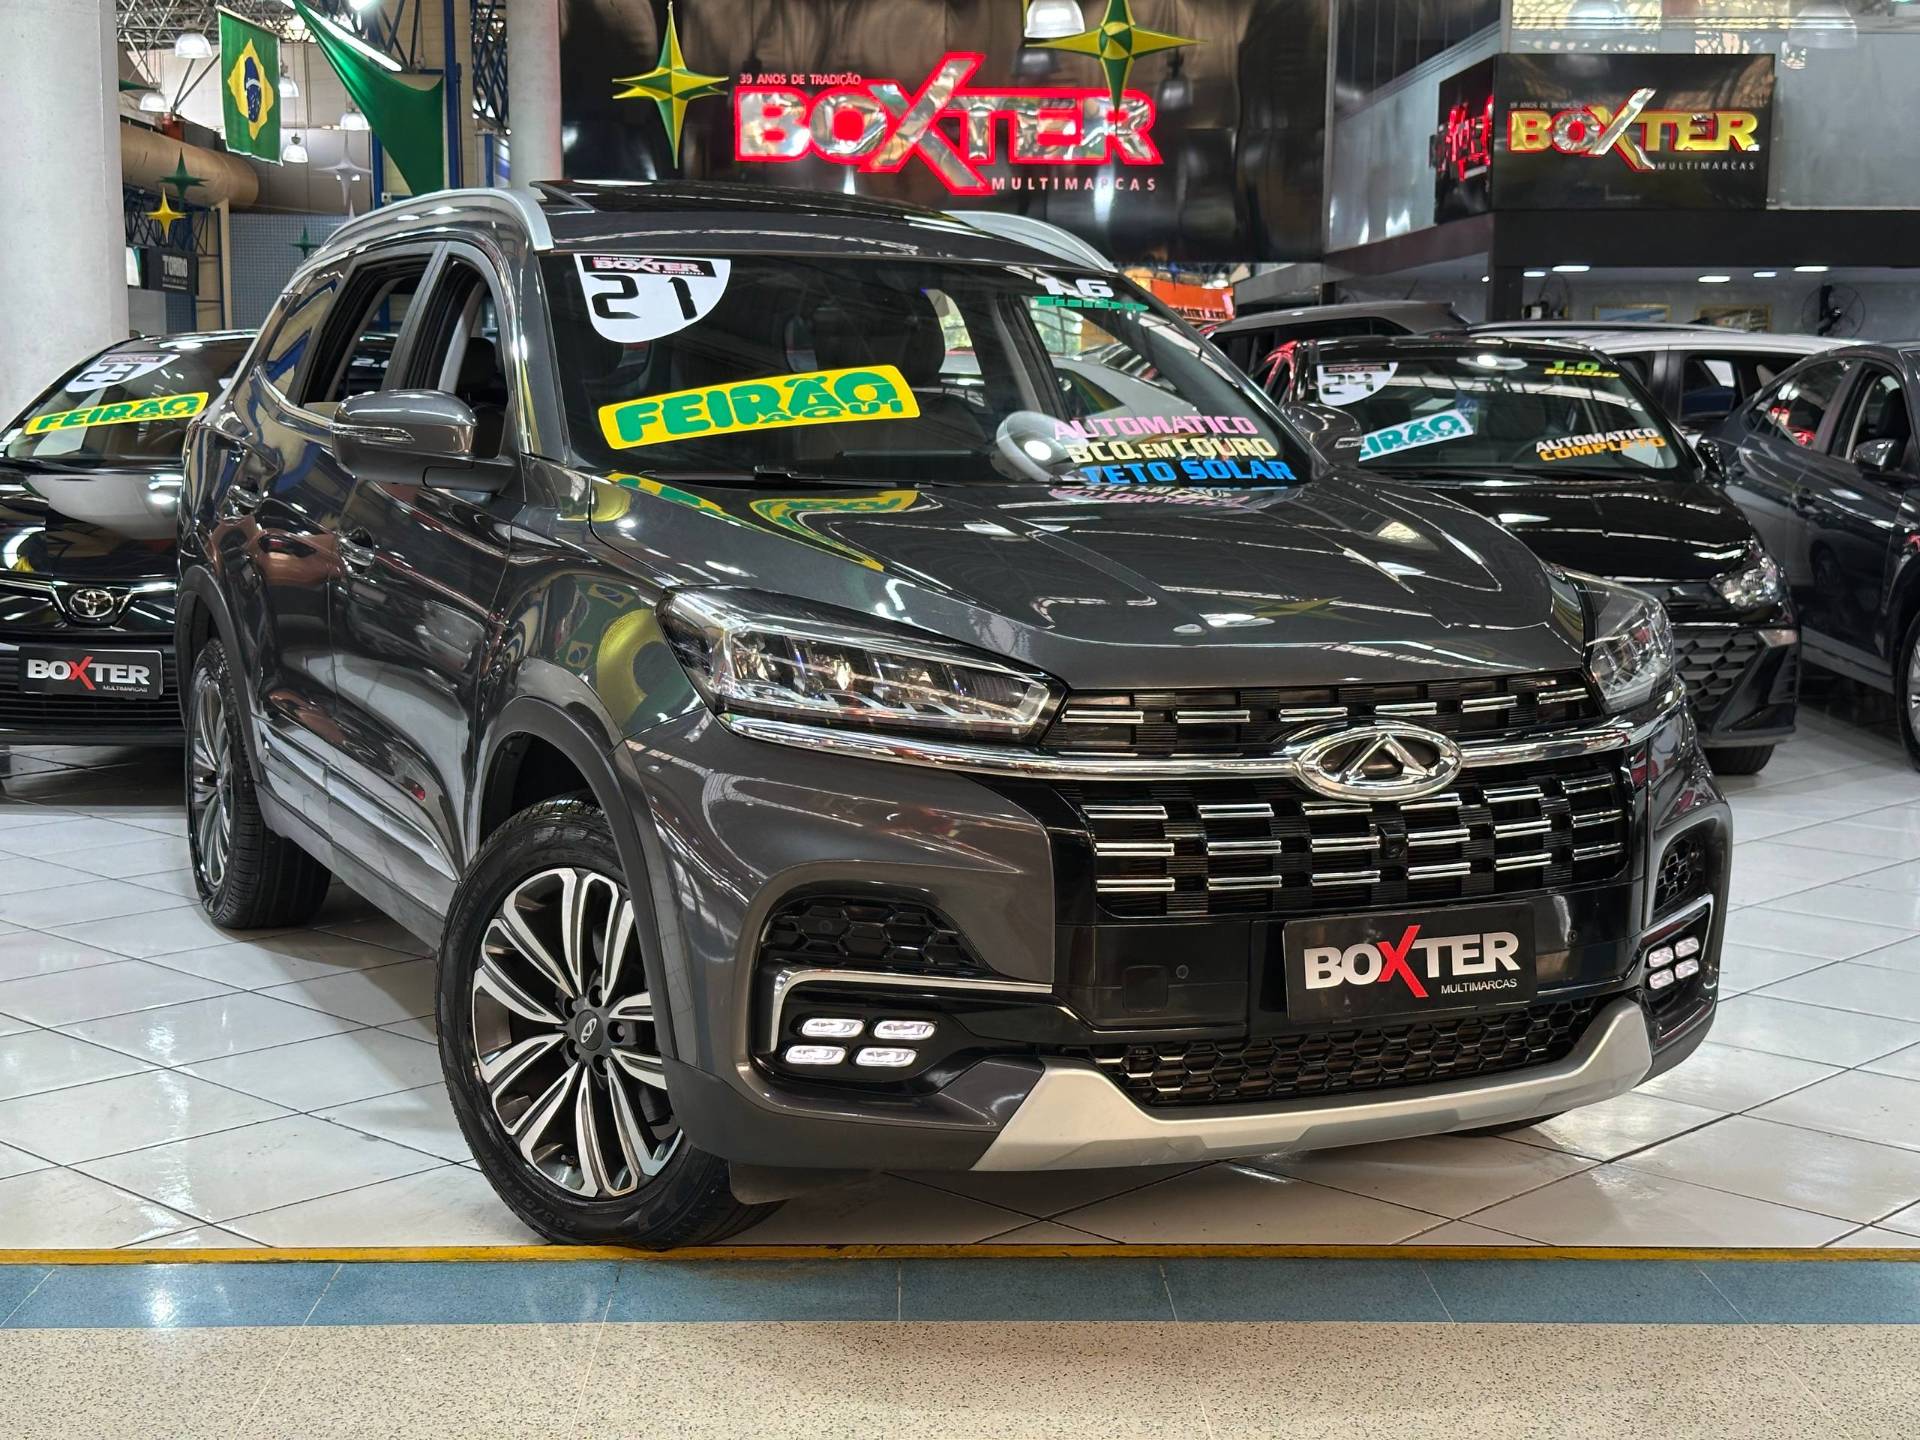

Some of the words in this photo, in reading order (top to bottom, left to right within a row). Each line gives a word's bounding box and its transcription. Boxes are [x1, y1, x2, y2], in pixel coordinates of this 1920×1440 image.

[740, 73, 753, 85] 39
[756, 73, 787, 85] ANOS
[791, 74, 806, 85] DE
[810, 72, 862, 87] TRADIÇÃO
[735, 52, 1163, 195] BOXTER
[1507, 88, 1760, 172] BOXTER
[1658, 160, 1755, 171] MULTIMARCAS
[992, 177, 1156, 192] MULTIMARCAS
[592, 258, 701, 274] BOXTER
[590, 275, 698, 320] 21
[76, 363, 141, 382] 23
[1552, 360, 1600, 371] 1.0
[615, 371, 899, 442] FEIRÃO
[1053, 416, 1259, 440] AUTOMATICO
[1536, 427, 1659, 453] AUTOMATICO
[1175, 438, 1277, 460] COURO
[1540, 437, 1667, 461] COMPLETO
[1080, 461, 1177, 484] TETO
[1181, 459, 1297, 481] SOLAR
[27, 656, 150, 690] BOXTER
[1304, 924, 1521, 998] BOXTER
[1441, 978, 1518, 994] MULTIMARCAS
